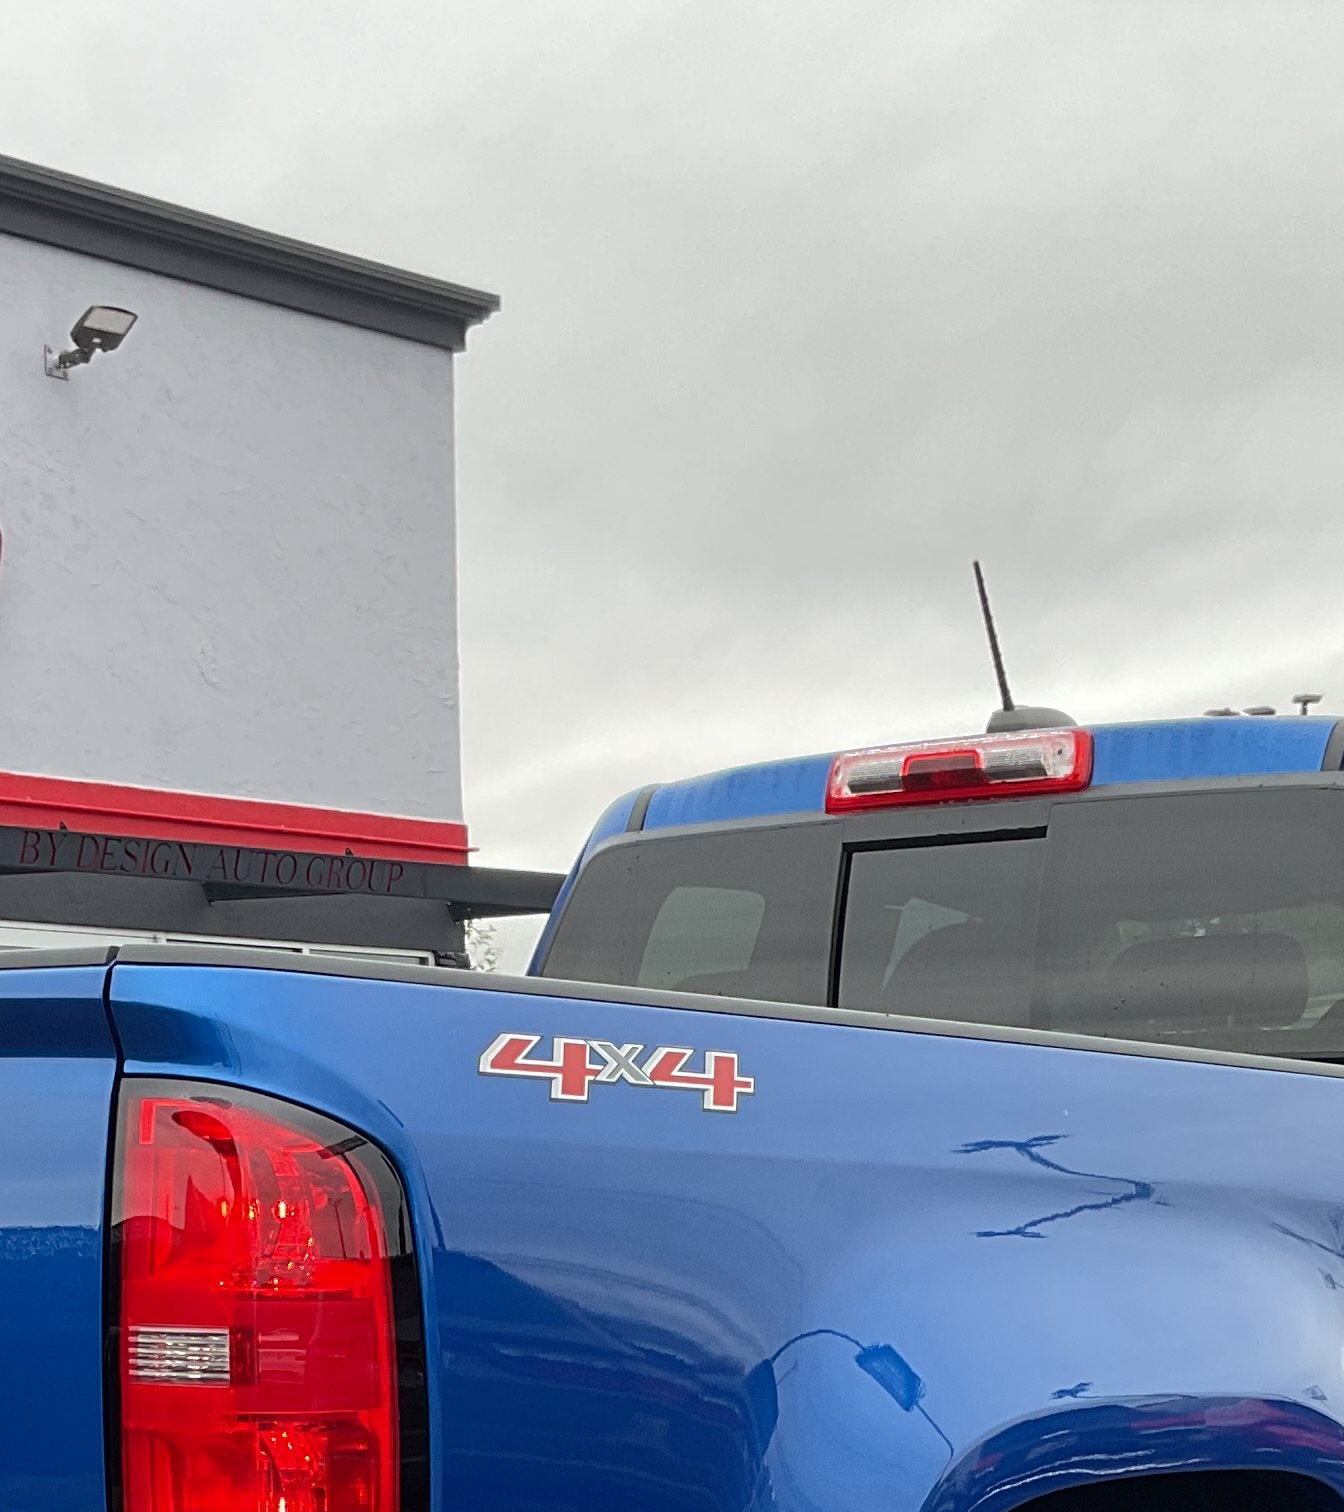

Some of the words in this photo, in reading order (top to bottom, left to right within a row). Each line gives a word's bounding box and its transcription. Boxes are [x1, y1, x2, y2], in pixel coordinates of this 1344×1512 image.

[19, 830, 68, 867] BY
[76, 834, 199, 877] DESIGN
[206, 848, 297, 885] AUTO
[306, 855, 405, 894] GROUP
